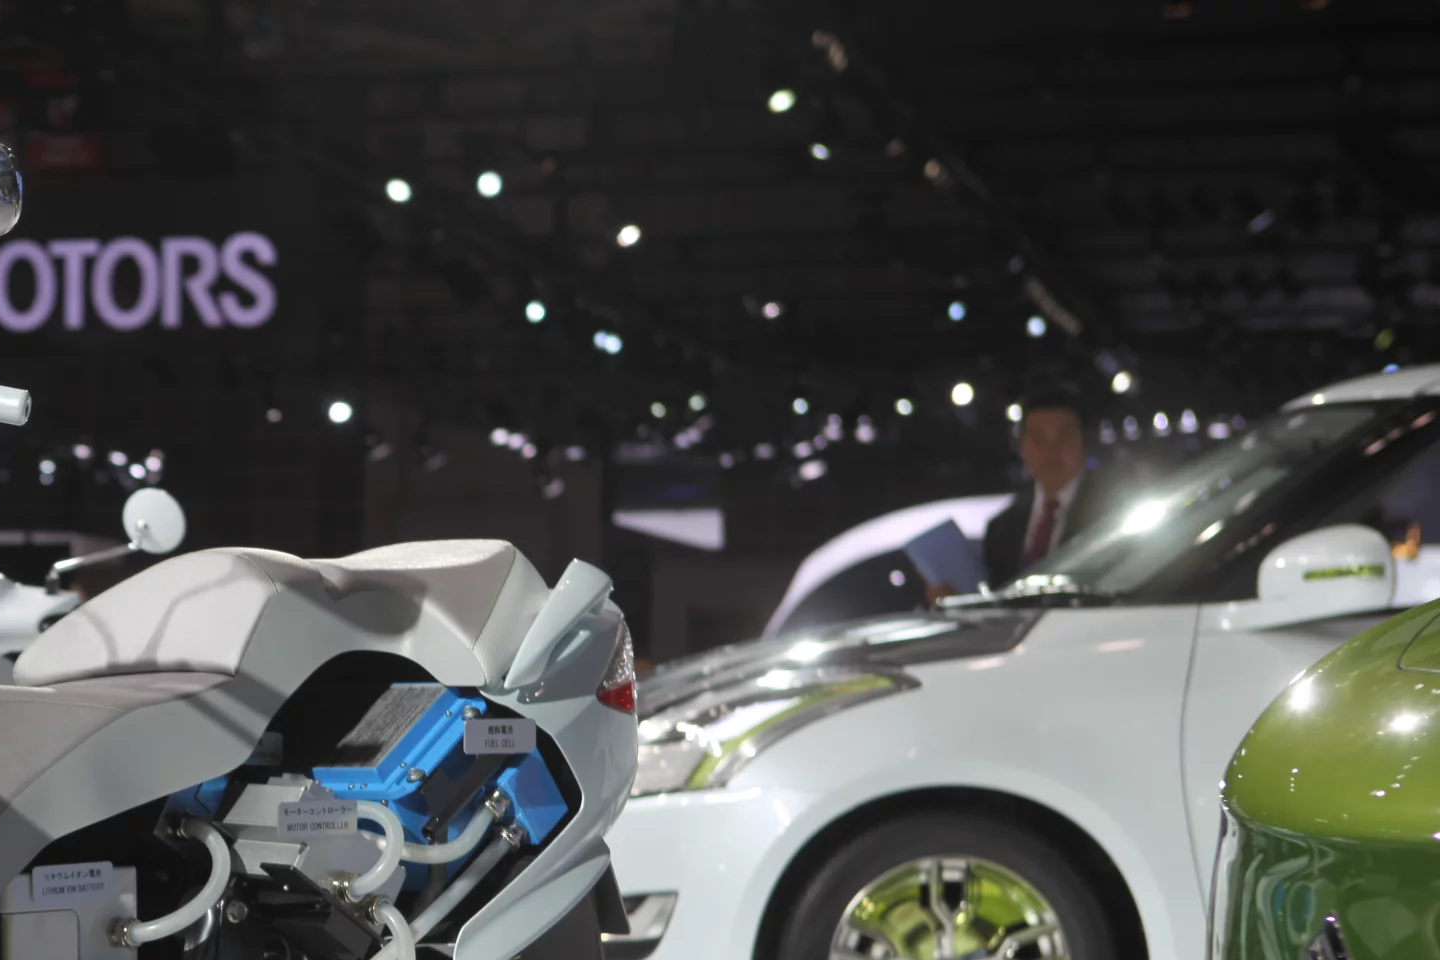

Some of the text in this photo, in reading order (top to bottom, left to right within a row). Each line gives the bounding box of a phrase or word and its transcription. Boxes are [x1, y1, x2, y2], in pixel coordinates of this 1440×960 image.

[484, 739, 499, 748] FUEL
[287, 820, 349, 832] MOTOR CONTROLLER
[42, 886, 66, 896] LITHIUM
[78, 882, 105, 893] BATTERY
